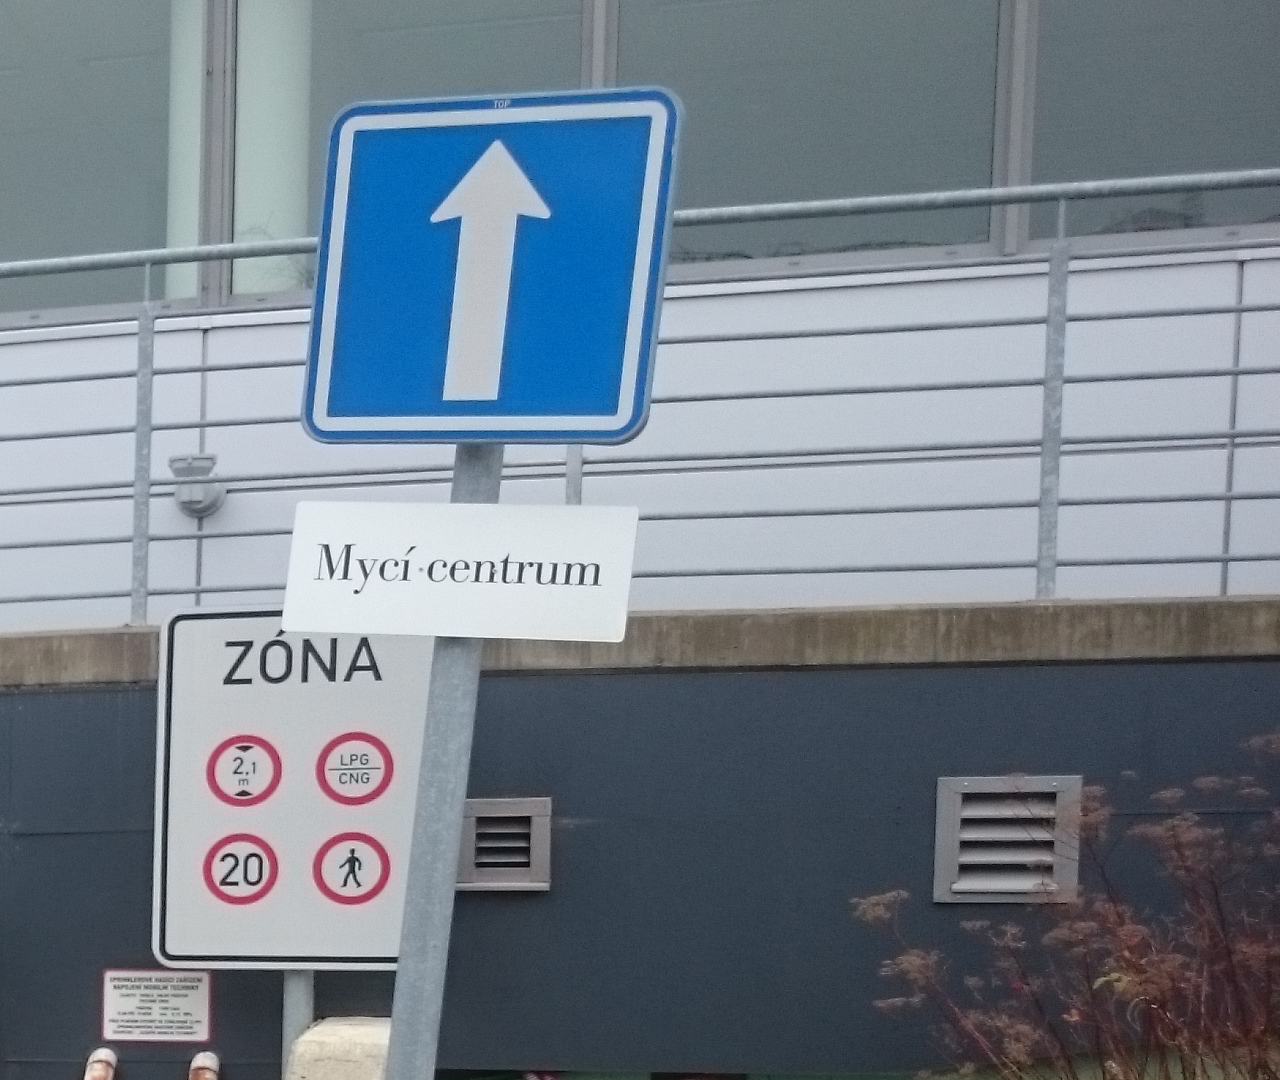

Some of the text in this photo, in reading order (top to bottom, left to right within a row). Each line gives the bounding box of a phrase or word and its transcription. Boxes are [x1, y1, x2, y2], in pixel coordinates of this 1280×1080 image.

[313, 543, 603, 595] Mycí centrum
[222, 630, 383, 685] ZÓNA
[340, 753, 370, 767] LPG
[238, 778, 249, 786] m
[338, 772, 370, 785] CNG
[218, 852, 264, 887] 20
